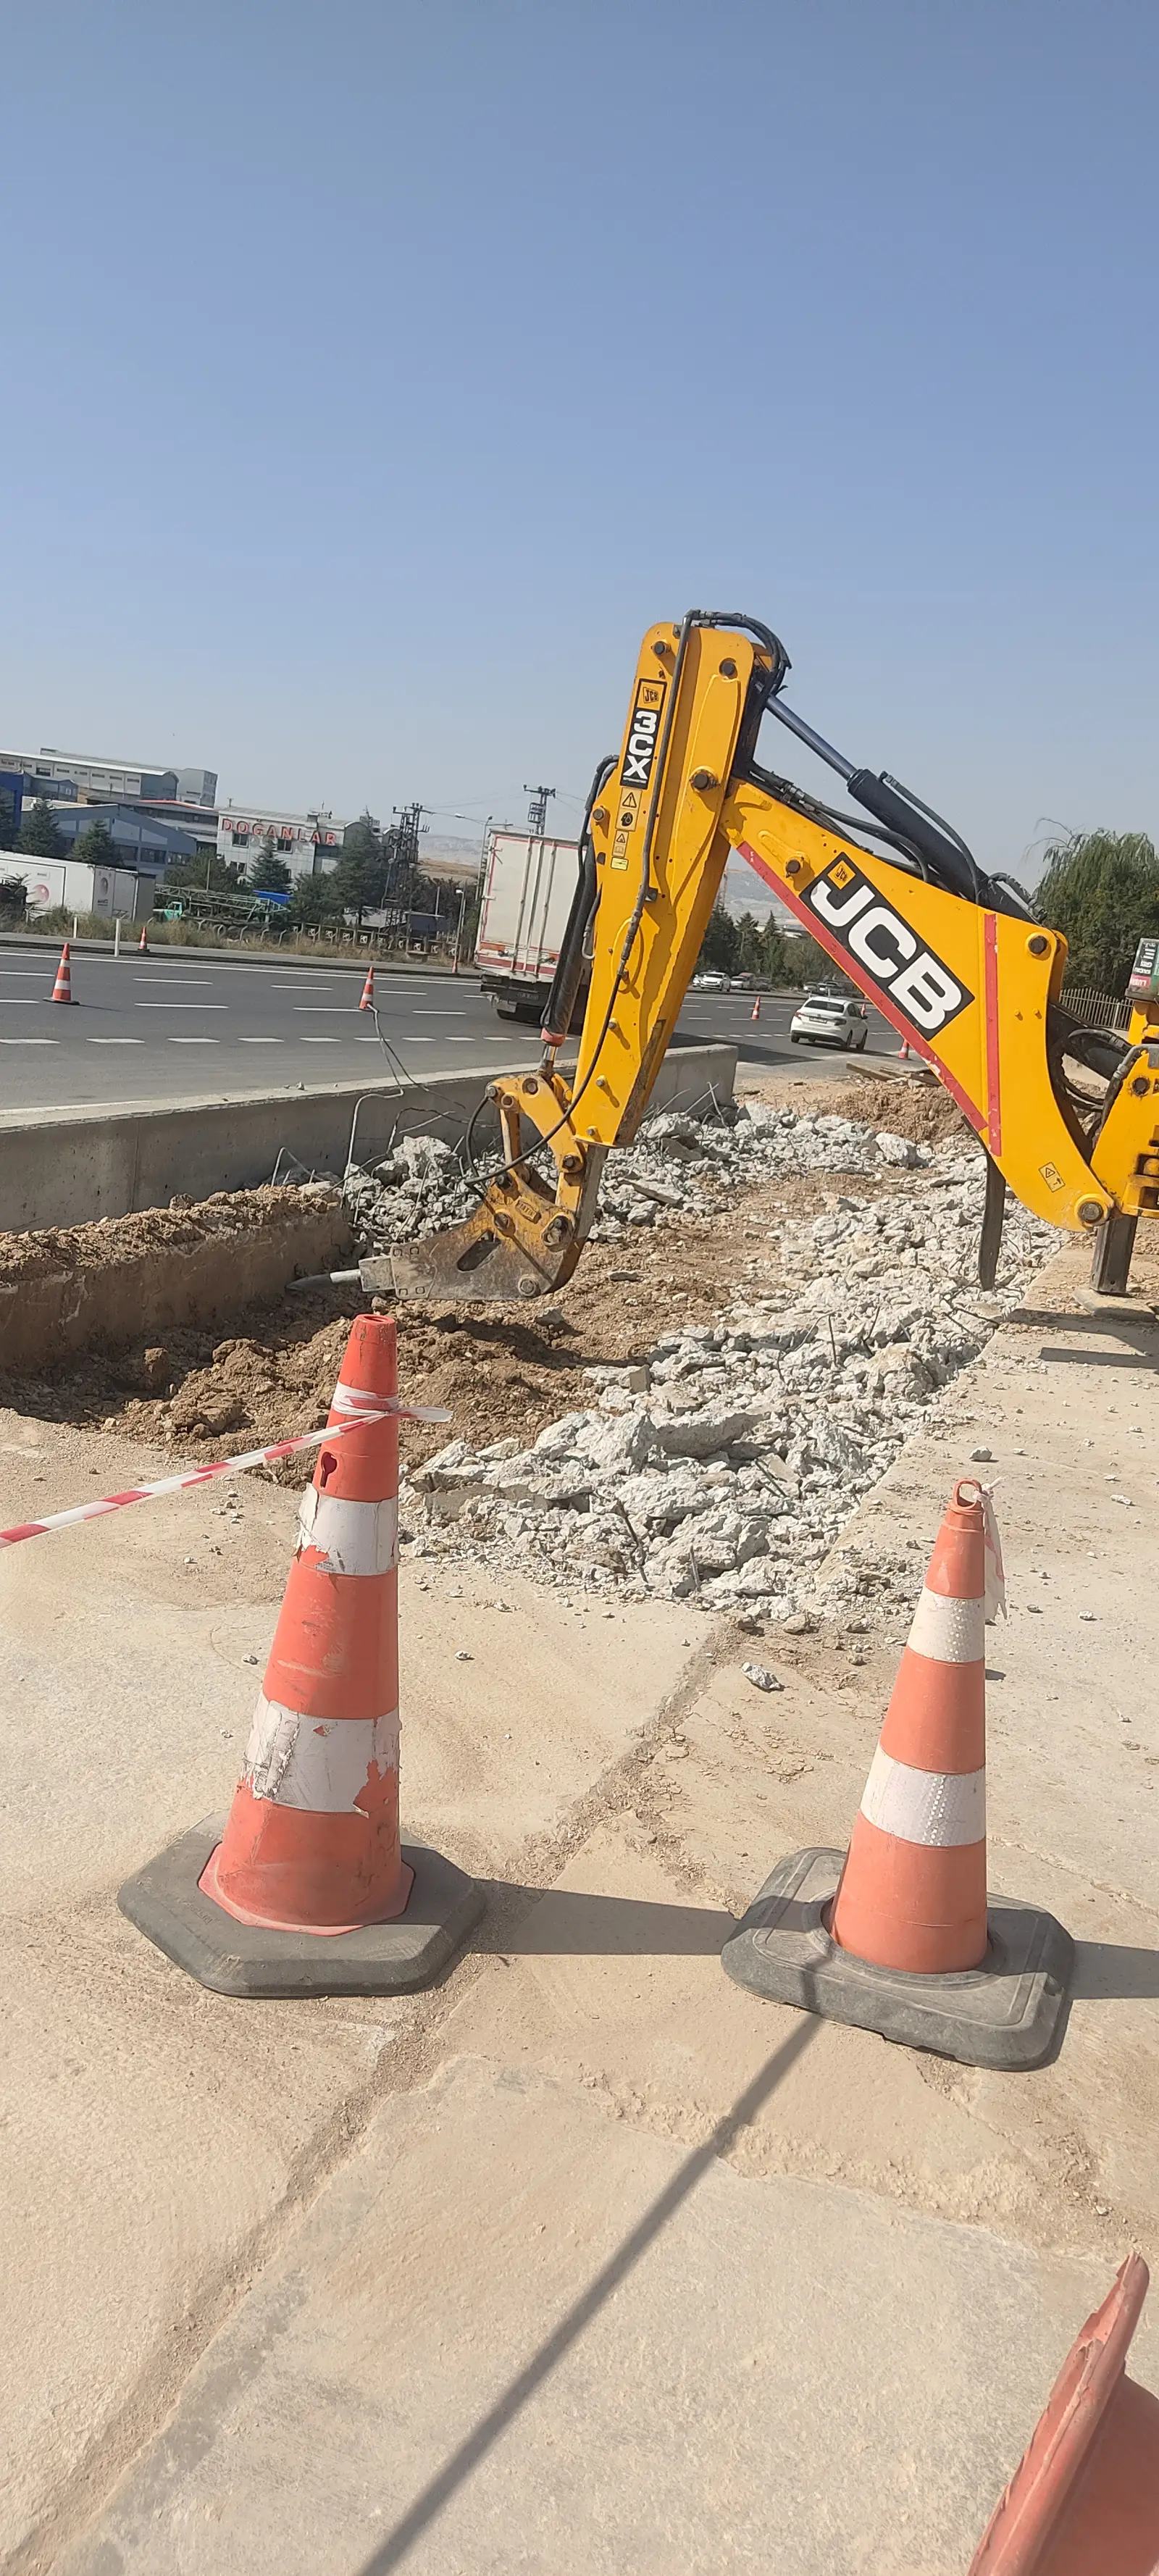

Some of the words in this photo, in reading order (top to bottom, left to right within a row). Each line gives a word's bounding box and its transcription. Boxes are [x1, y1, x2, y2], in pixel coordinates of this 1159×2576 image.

[644, 688, 658, 703] JCB
[623, 711, 657, 779] 3CX
[810, 880, 962, 1029] JCB
